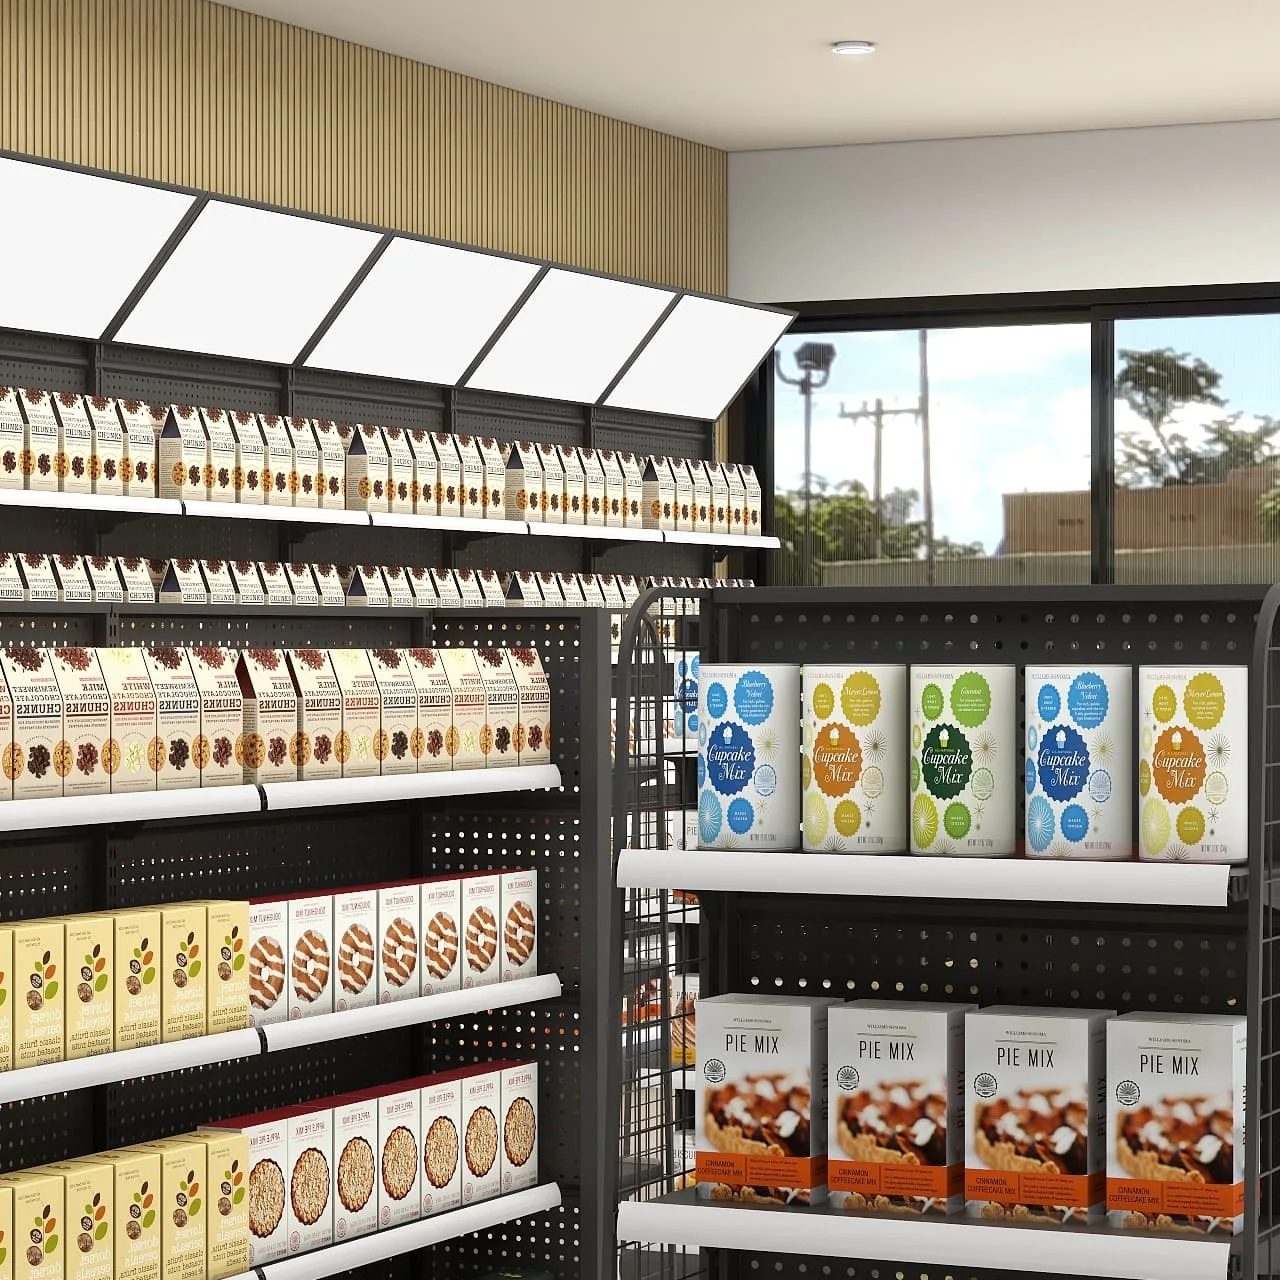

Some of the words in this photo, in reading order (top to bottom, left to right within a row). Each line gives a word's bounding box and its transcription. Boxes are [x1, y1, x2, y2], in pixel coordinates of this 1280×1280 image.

[1076, 681, 1102, 691] Blueberry
[708, 747, 751, 763] Cupcake
[815, 747, 859, 764] Cupcake
[924, 748, 968, 765] Cupcake
[1040, 749, 1086, 767] Cupcake
[1155, 750, 1202, 769] Cupcake
[719, 763, 746, 781] Mix
[825, 764, 853, 783] Mix
[935, 765, 964, 785] Mix
[1051, 767, 1081, 786] Mix
[1167, 769, 1196, 789] Mix
[726, 1034, 747, 1052] PIE
[755, 1036, 779, 1054] MIX
[859, 1041, 881, 1059] PIE
[889, 1042, 914, 1061] MIX
[997, 1047, 1020, 1066] PIE
[1029, 1049, 1054, 1068] MIX
[1140, 1054, 1163, 1074] PIE
[1172, 1056, 1199, 1075] MIX
[1118, 1186, 1150, 1195] CINNAMON
